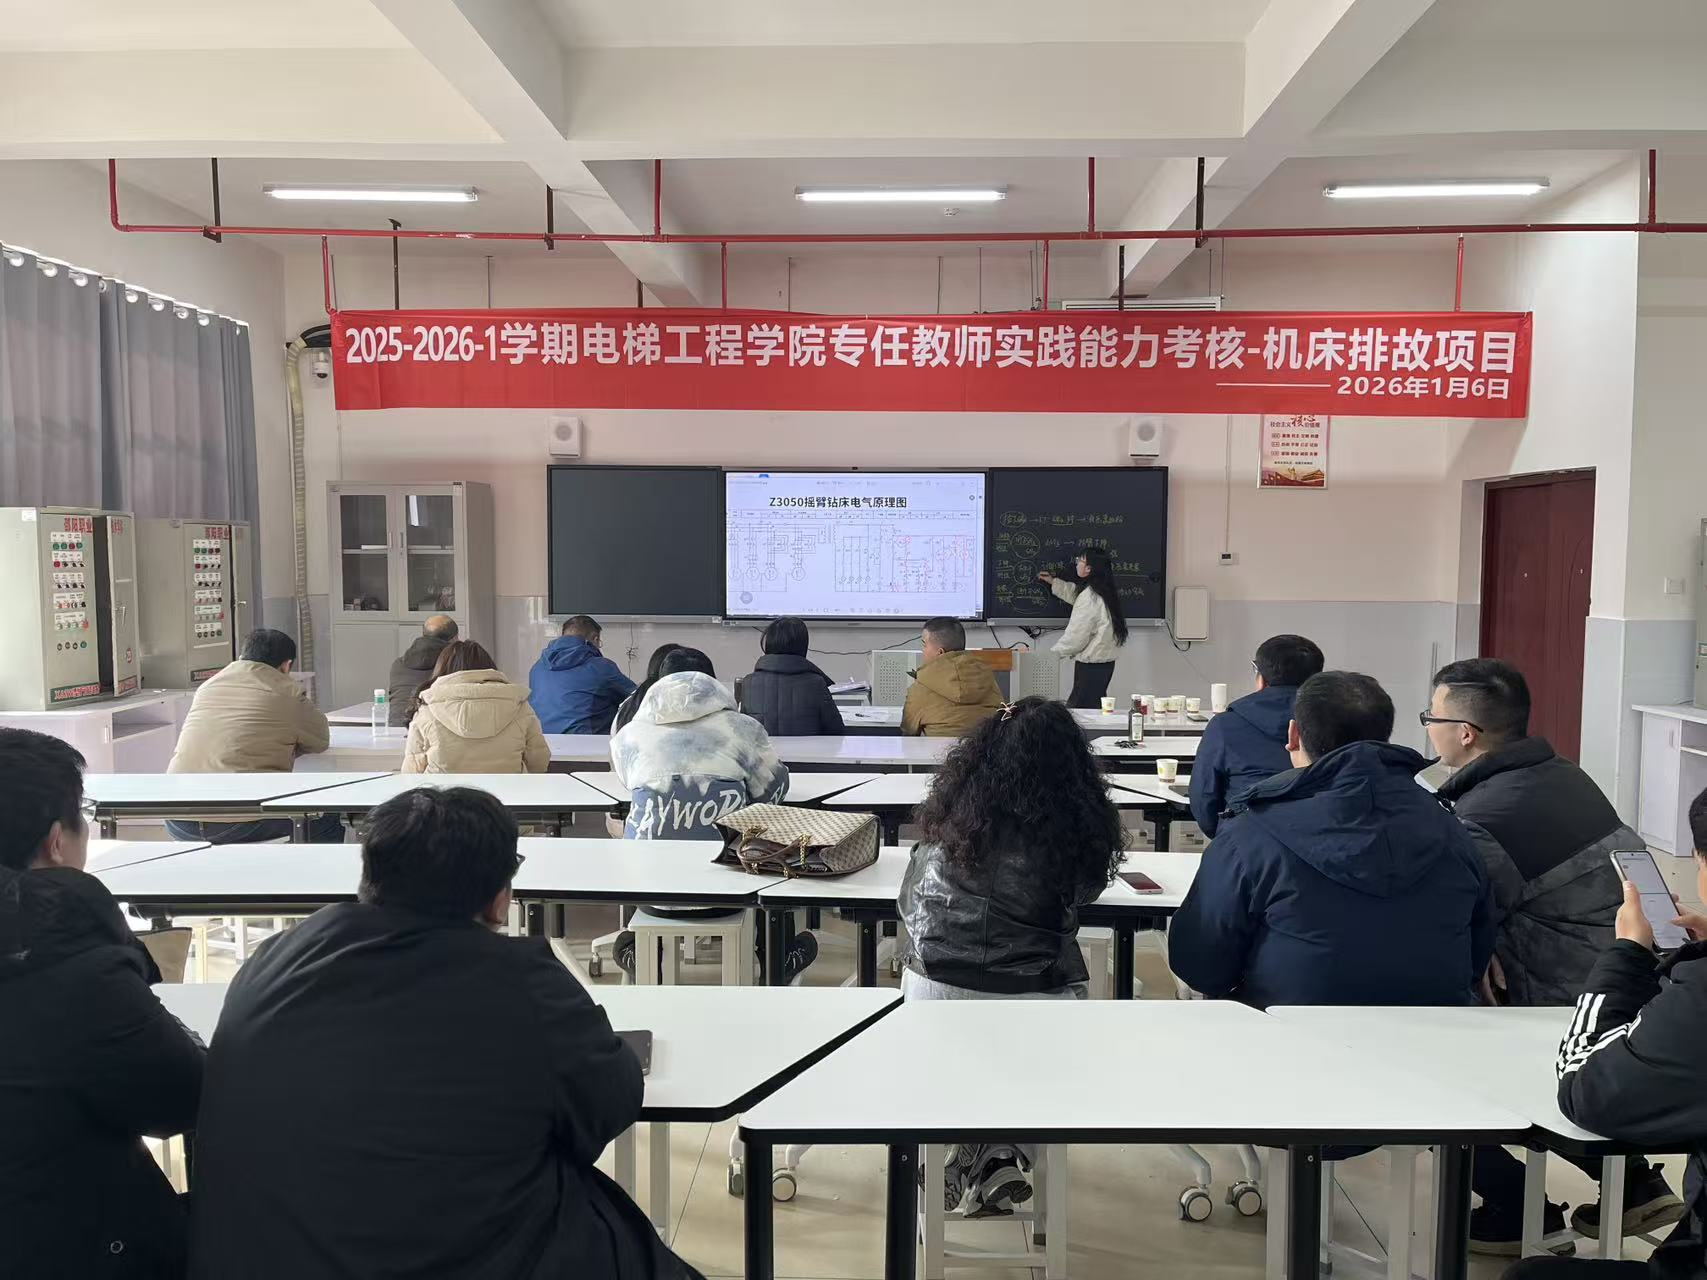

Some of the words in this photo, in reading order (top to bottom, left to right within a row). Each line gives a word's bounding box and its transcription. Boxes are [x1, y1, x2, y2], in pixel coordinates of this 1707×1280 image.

[345, 321, 1517, 374] 2025-2026-1学期电梯工程学院专任教师实践能力考核-机床排故项目
[1337, 376, 1510, 400] 2026年1月6日
[769, 496, 907, 508] Z3050摇臂钻床电气原理图
